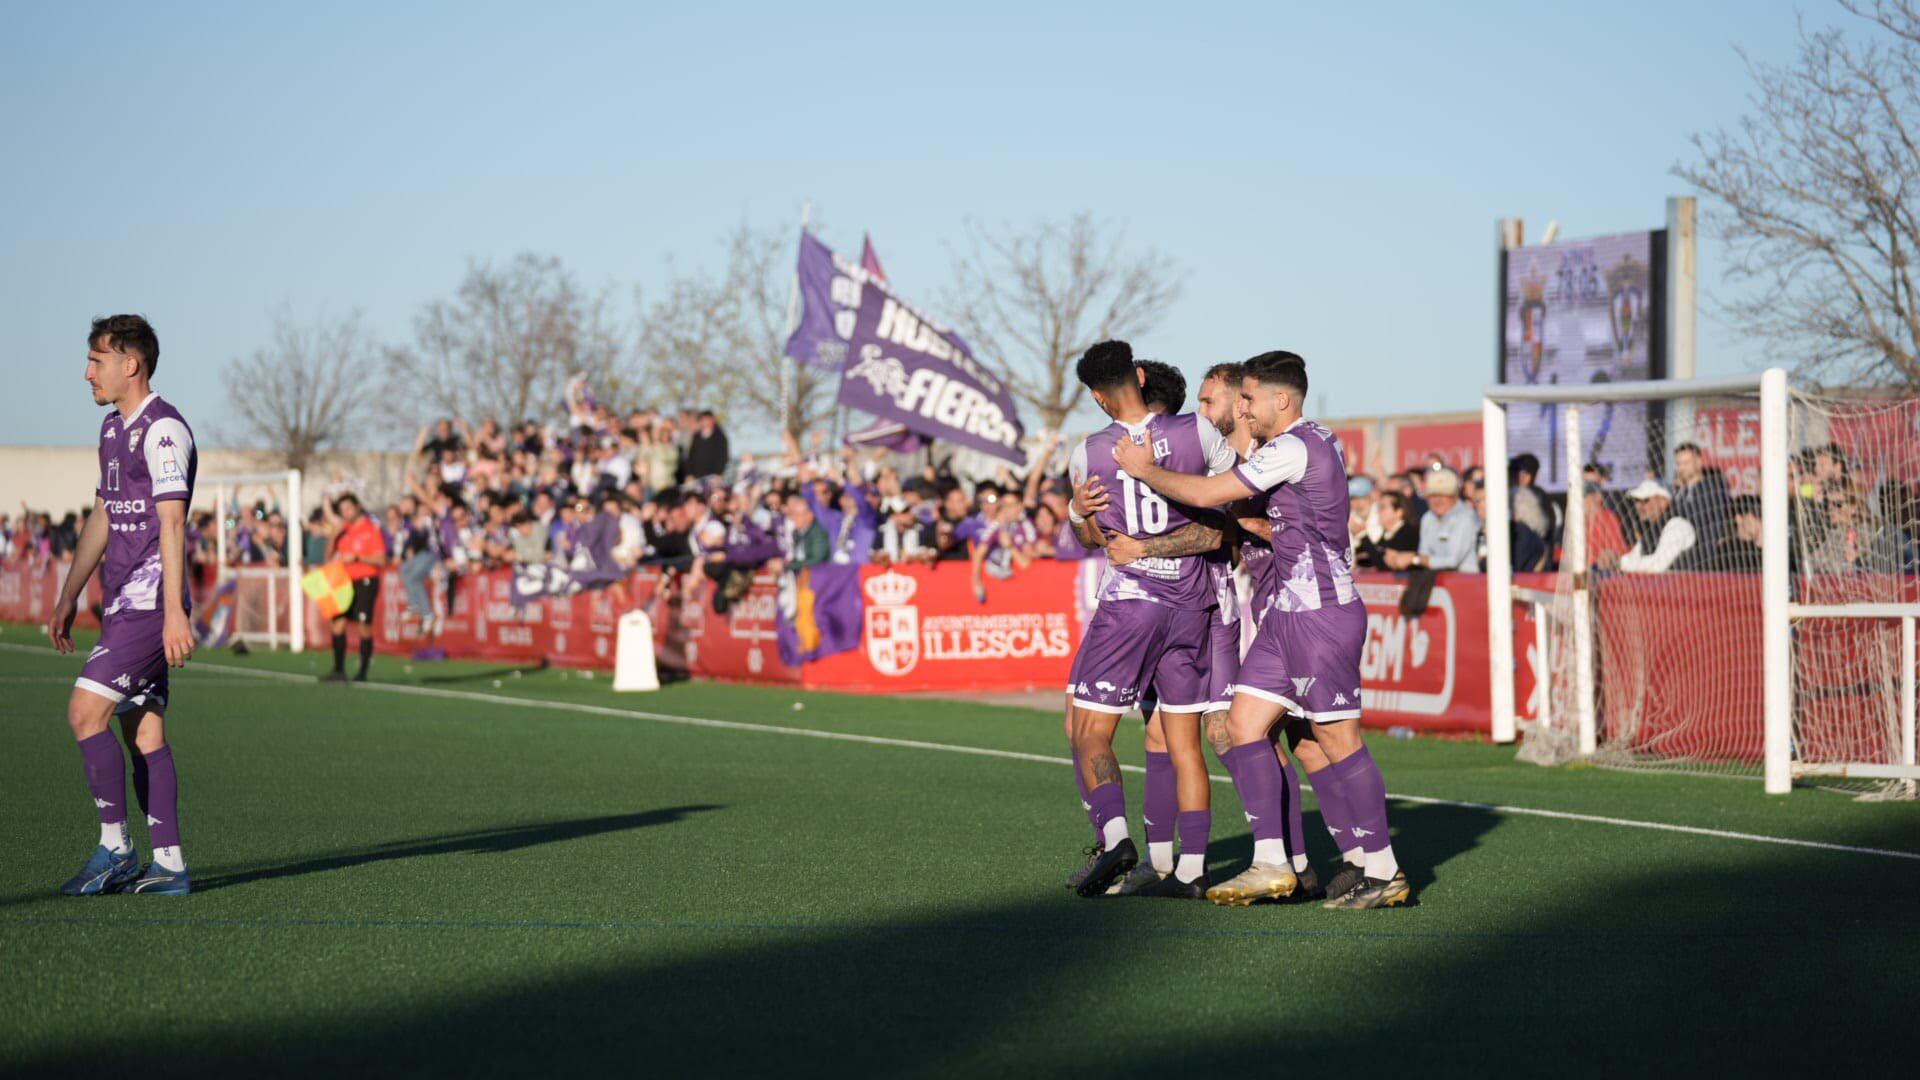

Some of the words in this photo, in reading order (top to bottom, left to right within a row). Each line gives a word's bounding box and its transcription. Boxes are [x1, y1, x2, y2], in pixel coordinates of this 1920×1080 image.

[1116, 469, 1168, 535] 18
[923, 614, 1044, 630] AYUNTAMIENTO
[1045, 613, 1067, 630] DE
[923, 629, 1071, 660] ILLESCAS
[1361, 613, 1406, 682] GM
